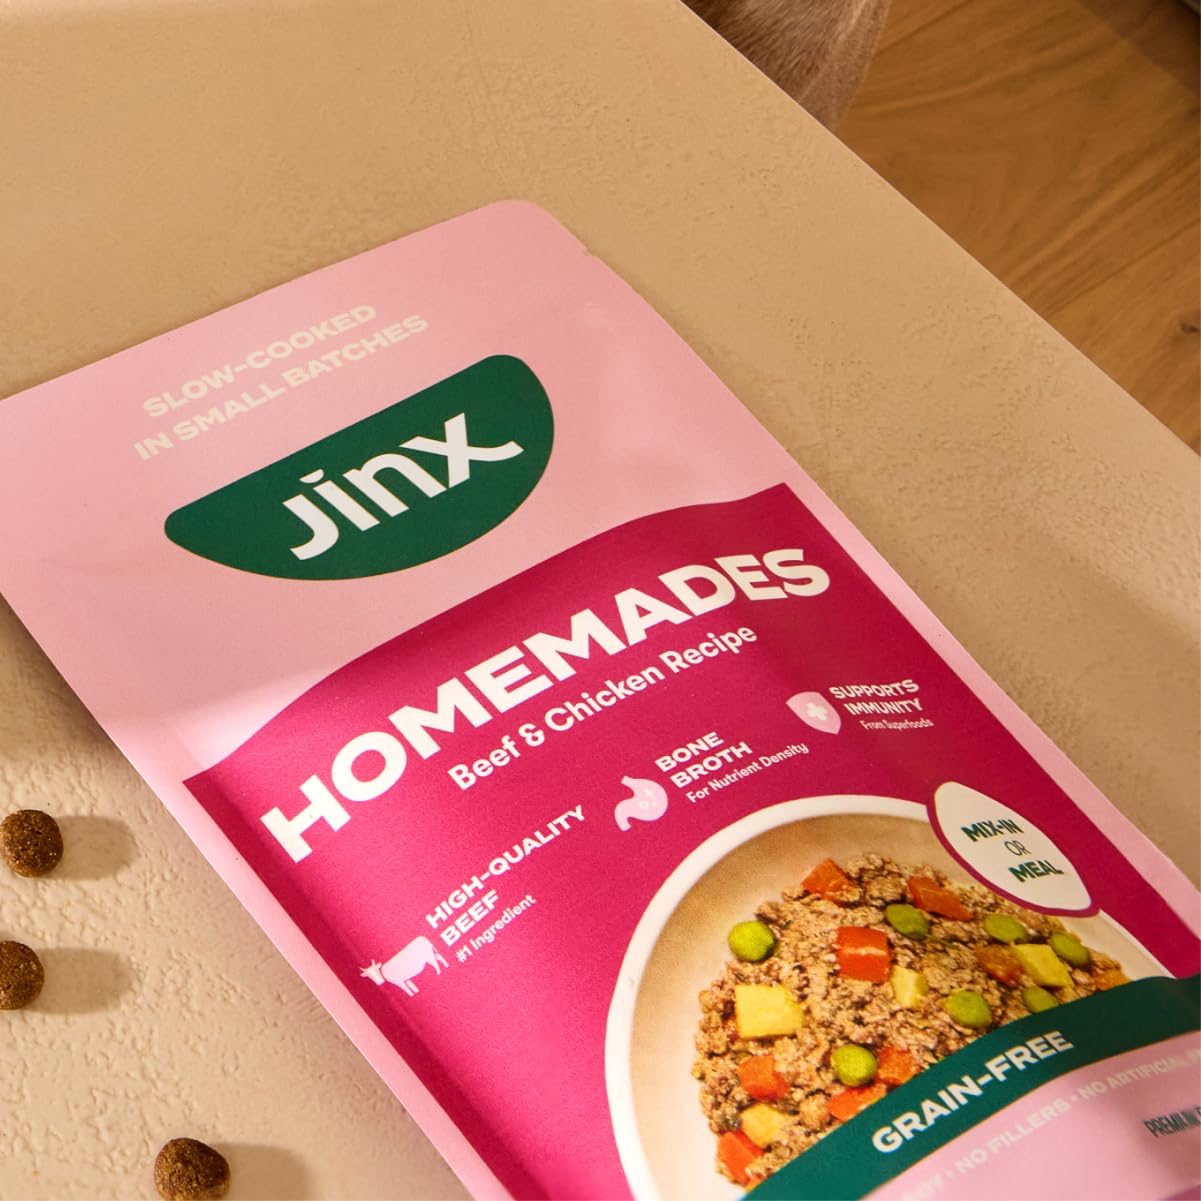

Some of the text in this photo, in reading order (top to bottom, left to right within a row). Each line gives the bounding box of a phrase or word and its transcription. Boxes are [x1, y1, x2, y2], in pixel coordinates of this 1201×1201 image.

[133, 315, 429, 461] IN SMALL BATCHES
[143, 305, 377, 417] SLOW-COOKED
[259, 548, 830, 863] HOMEMADES
[448, 626, 758, 791] Beef & Chicken Recipe
[829, 679, 920, 700] SUPPORTS
[844, 698, 924, 716] IMMUNITY
[655, 731, 724, 772] BONE
[860, 719, 885, 730] From
[669, 741, 752, 789] BROTH
[685, 743, 809, 804] For Nutrient Density
[961, 818, 1024, 843] MIX-IN
[1004, 840, 1031, 856] OR
[425, 804, 585, 929] HIGH-QUALITY
[1008, 860, 1065, 882] MEAL
[440, 889, 499, 947] BEEF
[455, 893, 536, 963] #1 Ingredient
[872, 1030, 1075, 1153] GRAIN-FREE
[954, 1149, 988, 1174] NO
[988, 1098, 1072, 1154] FILLERS
[1077, 1080, 1107, 1099] NO
